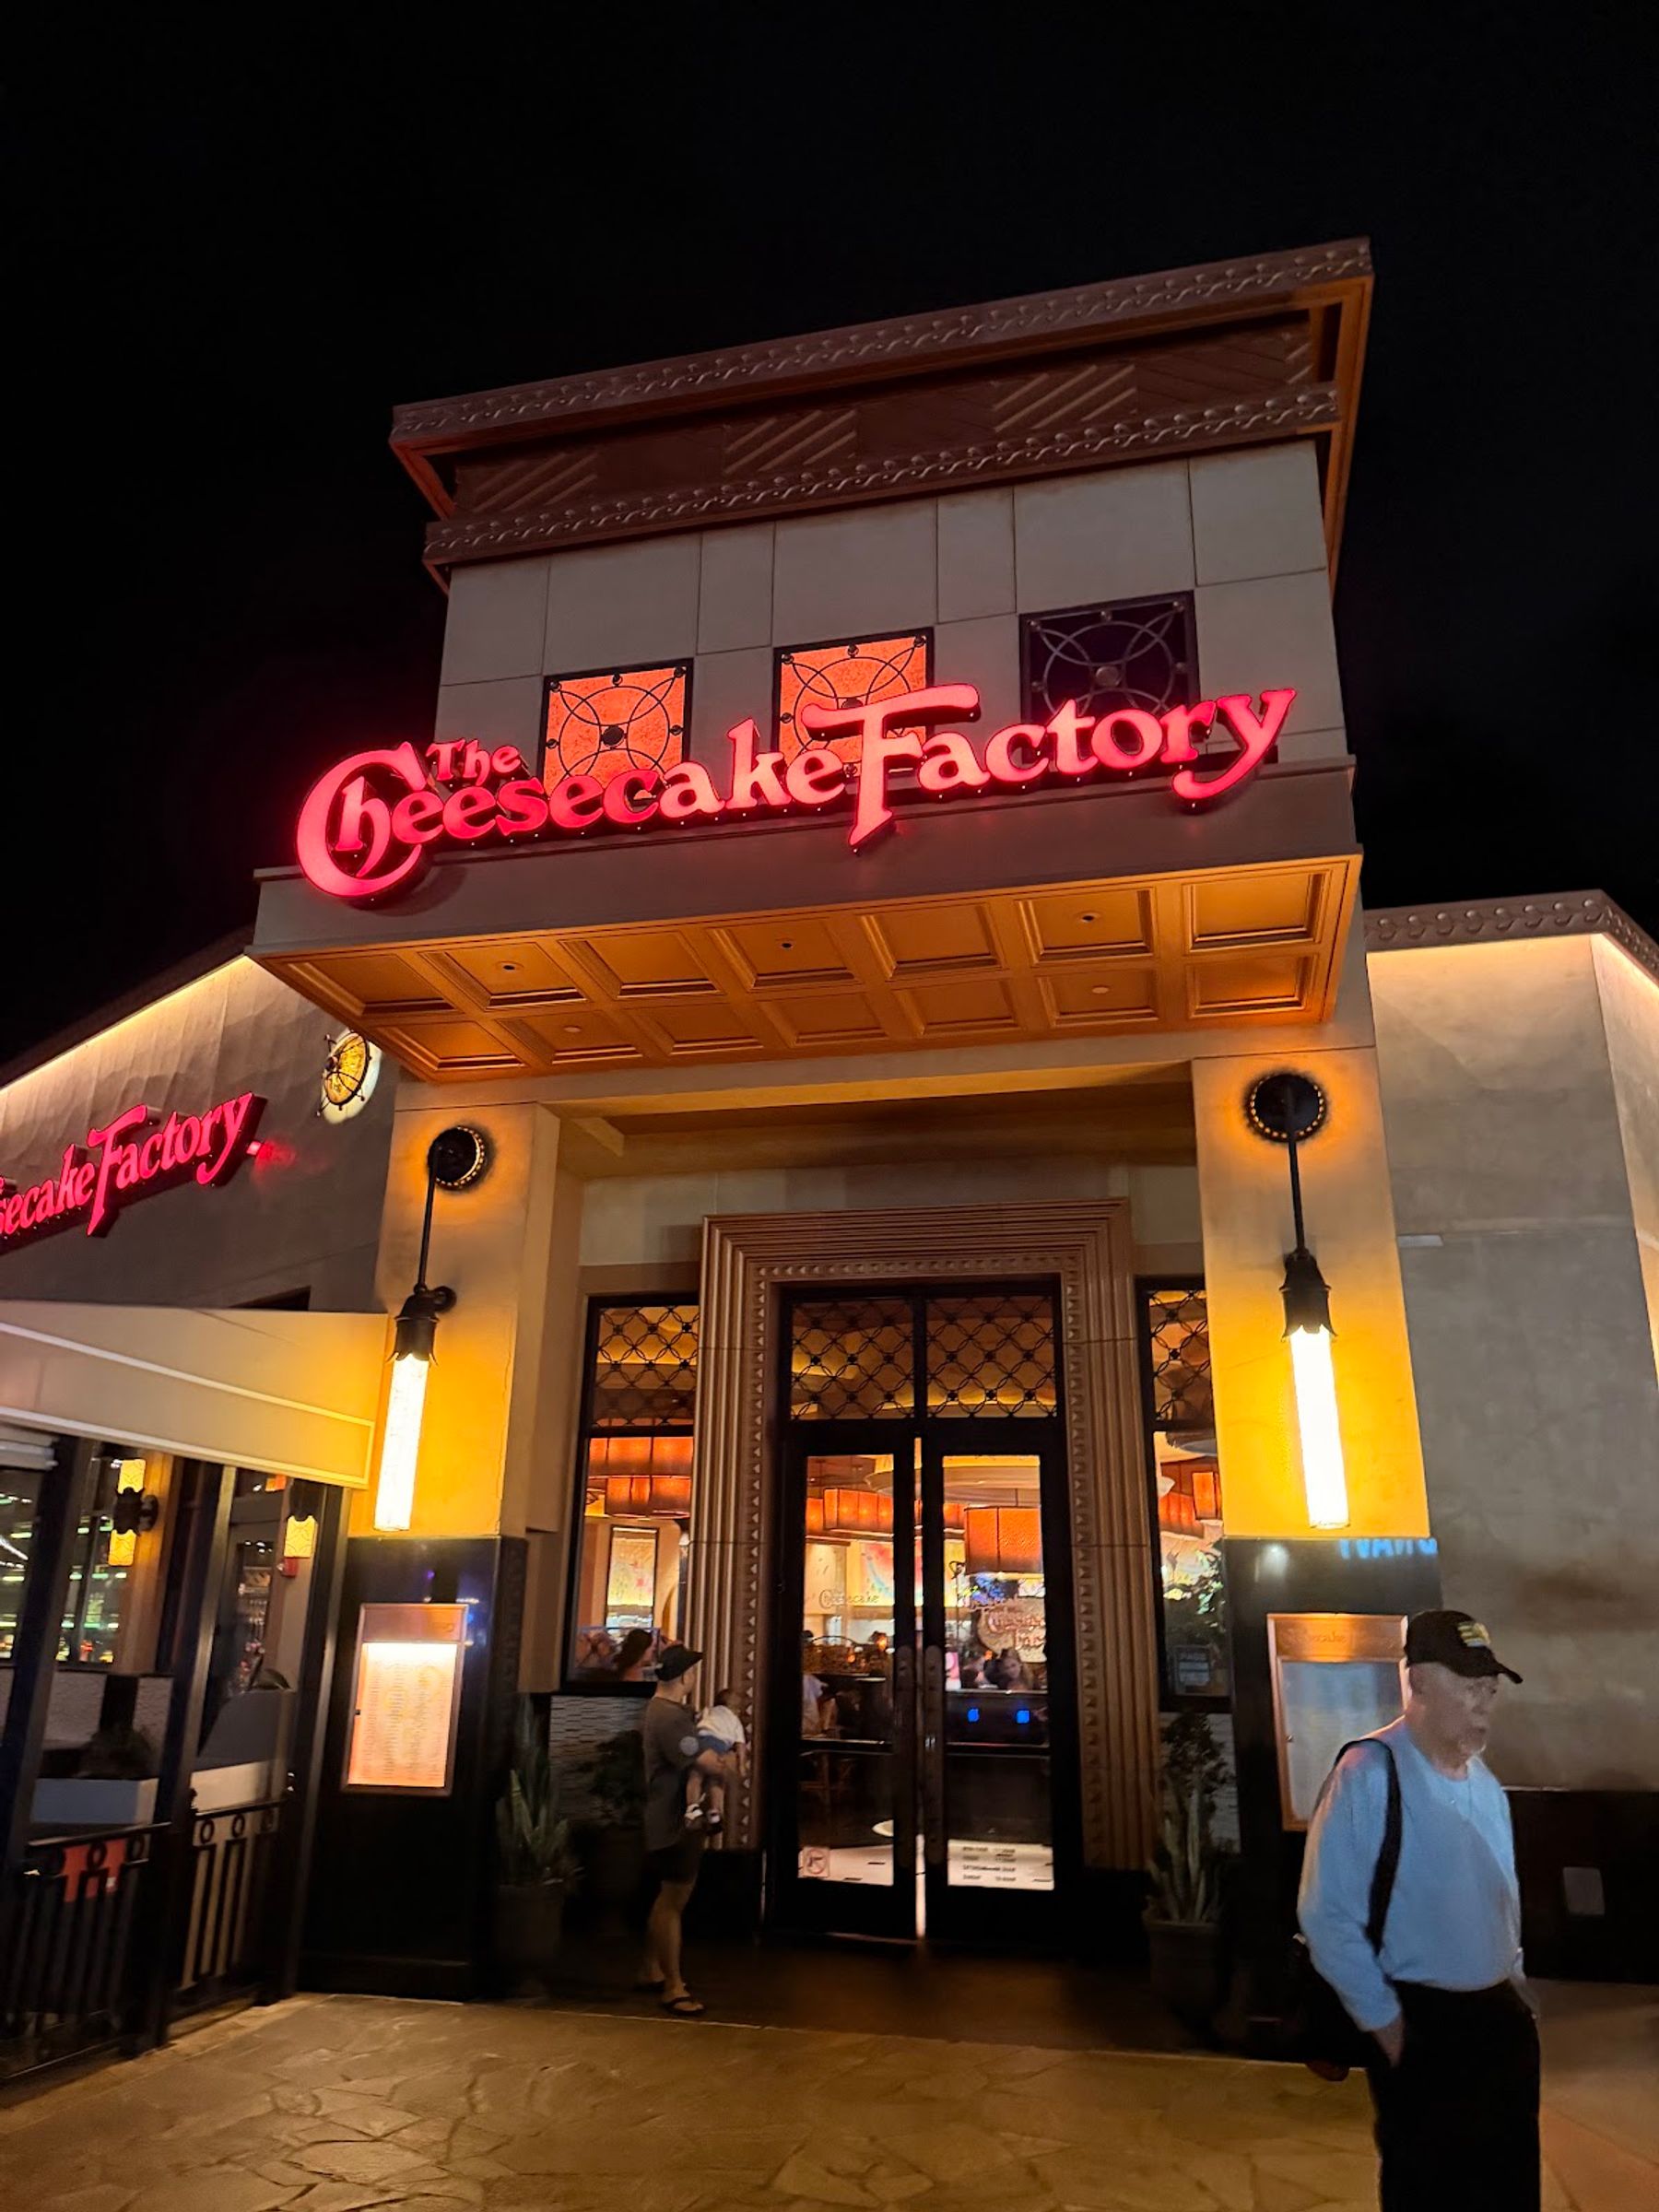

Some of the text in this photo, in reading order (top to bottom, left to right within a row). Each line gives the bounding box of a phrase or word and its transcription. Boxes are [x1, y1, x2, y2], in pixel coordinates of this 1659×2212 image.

[295, 683, 1297, 898] Cheesecake Factory
[426, 739, 524, 785] The
[87, 1092, 253, 1236] Factory
